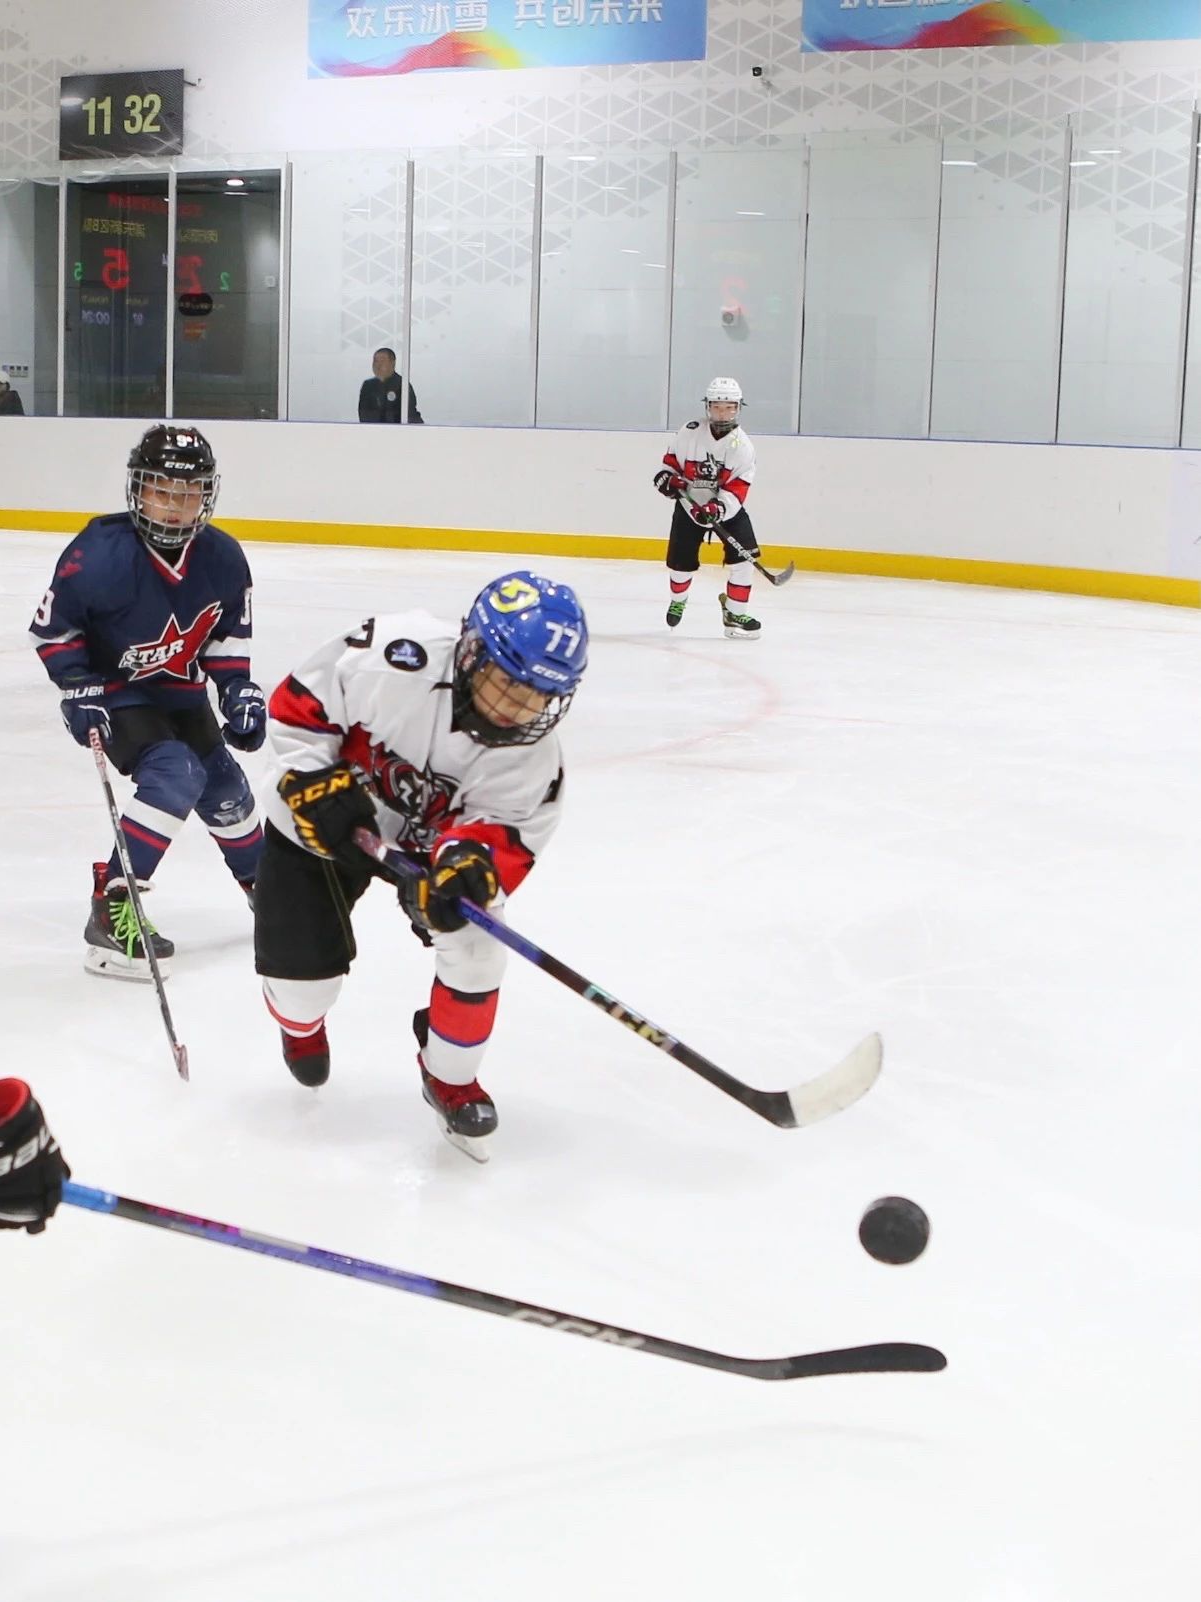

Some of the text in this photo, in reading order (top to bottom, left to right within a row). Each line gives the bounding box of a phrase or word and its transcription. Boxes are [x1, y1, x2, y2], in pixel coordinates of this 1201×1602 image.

[346, 2, 488, 38] 欢乐冰雪
[82, 94, 162, 135] 11 32
[164, 461, 196, 470] CCM
[123, 639, 185, 667] STAR
[545, 621, 581, 658] 77
[531, 664, 569, 682] CCM
[288, 769, 351, 813] CCM
